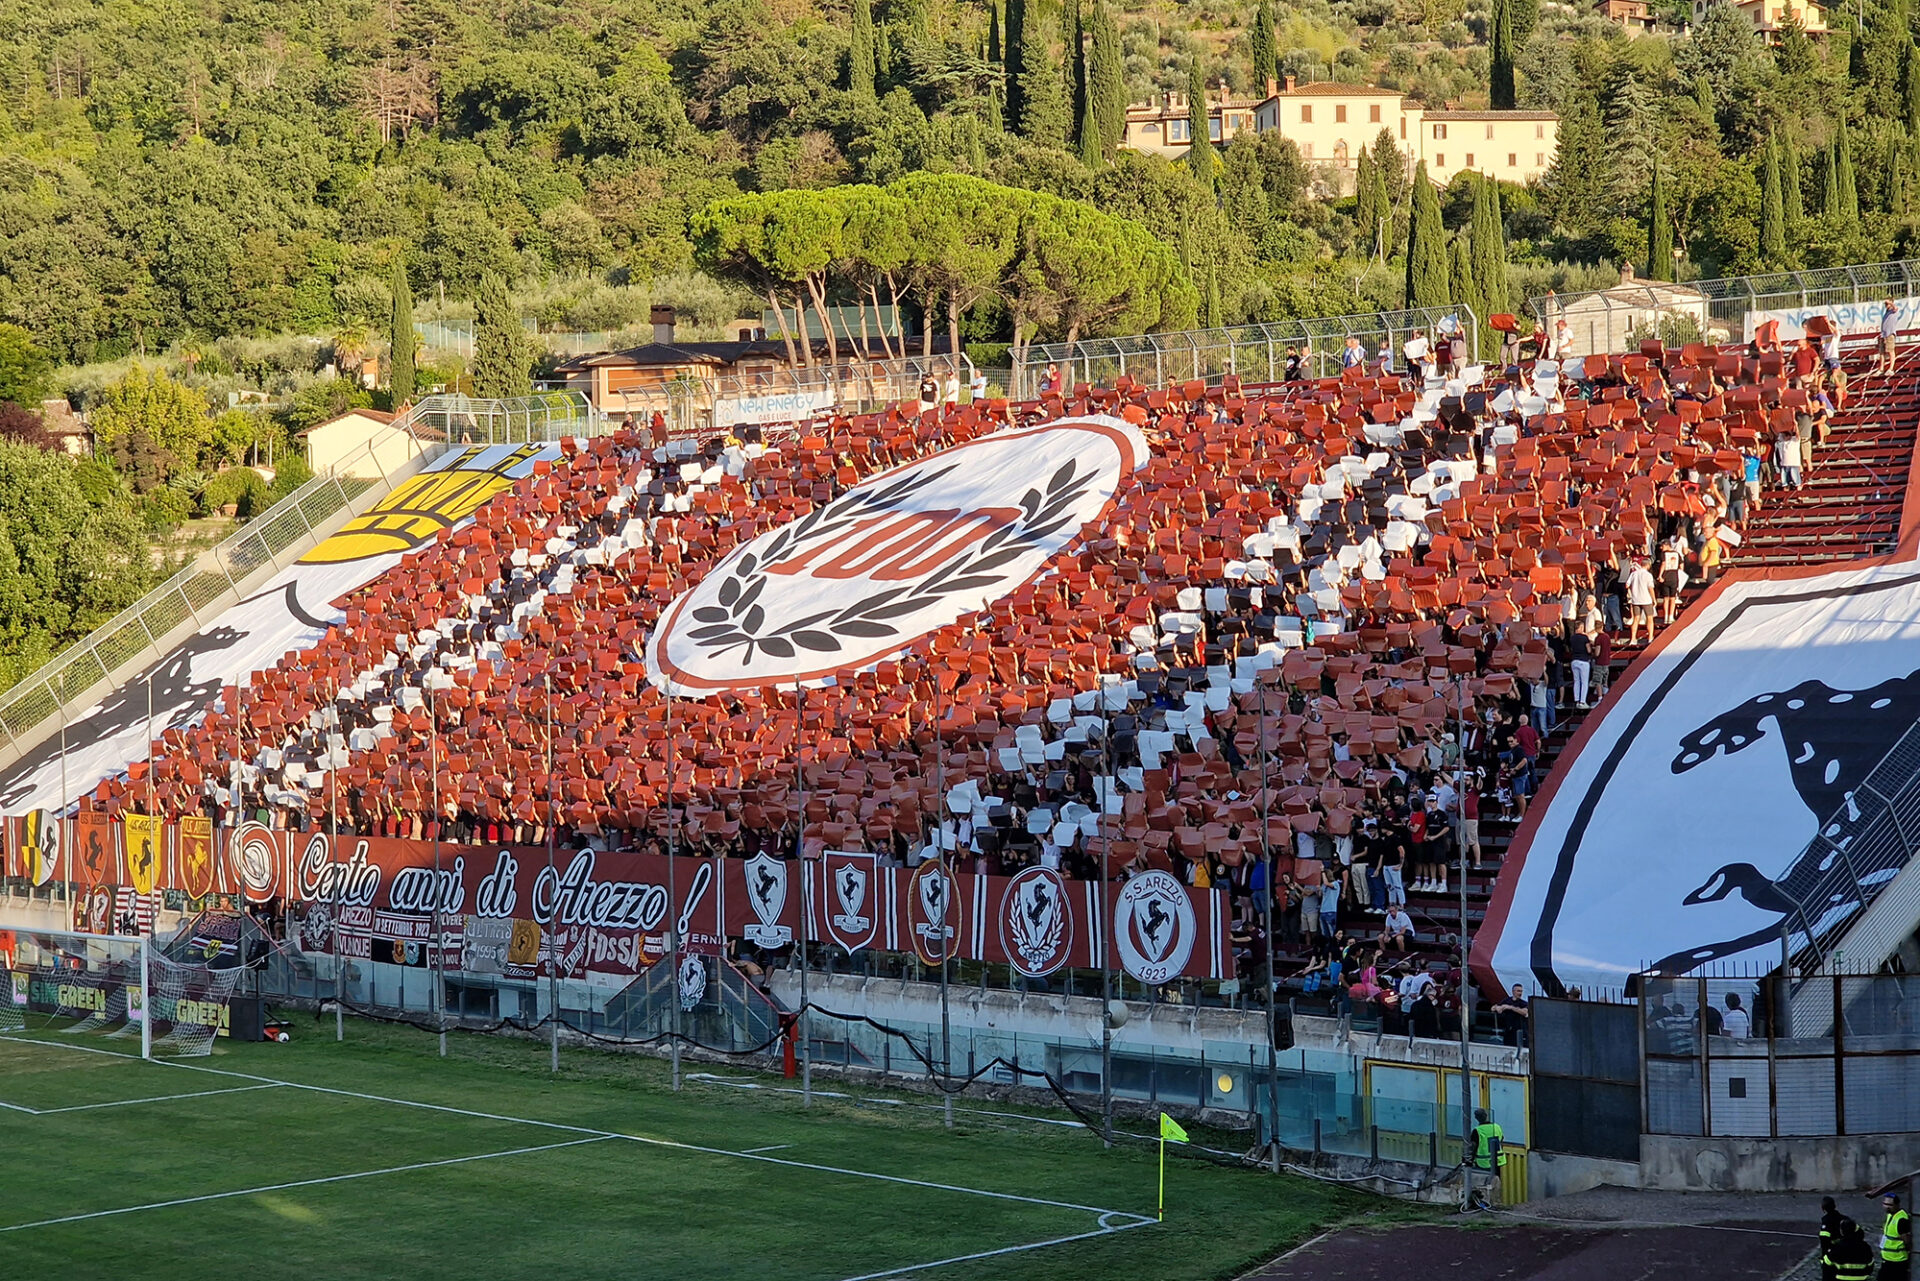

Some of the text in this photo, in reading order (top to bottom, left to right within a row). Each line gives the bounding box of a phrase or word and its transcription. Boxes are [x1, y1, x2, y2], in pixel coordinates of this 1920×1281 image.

[758, 413, 771, 422] GAS
[776, 411, 792, 421] LUCE
[762, 506, 1024, 581] 100
[299, 831, 381, 906] Cento
[389, 855, 465, 915] anni
[476, 850, 519, 918] di
[532, 848, 668, 930] Arezzo
[340, 905, 372, 926] AREZZO
[415, 922, 430, 937] 1923
[476, 945, 497, 959] 1995
[585, 926, 640, 973] FOSSA
[1138, 966, 1167, 980] 1923
